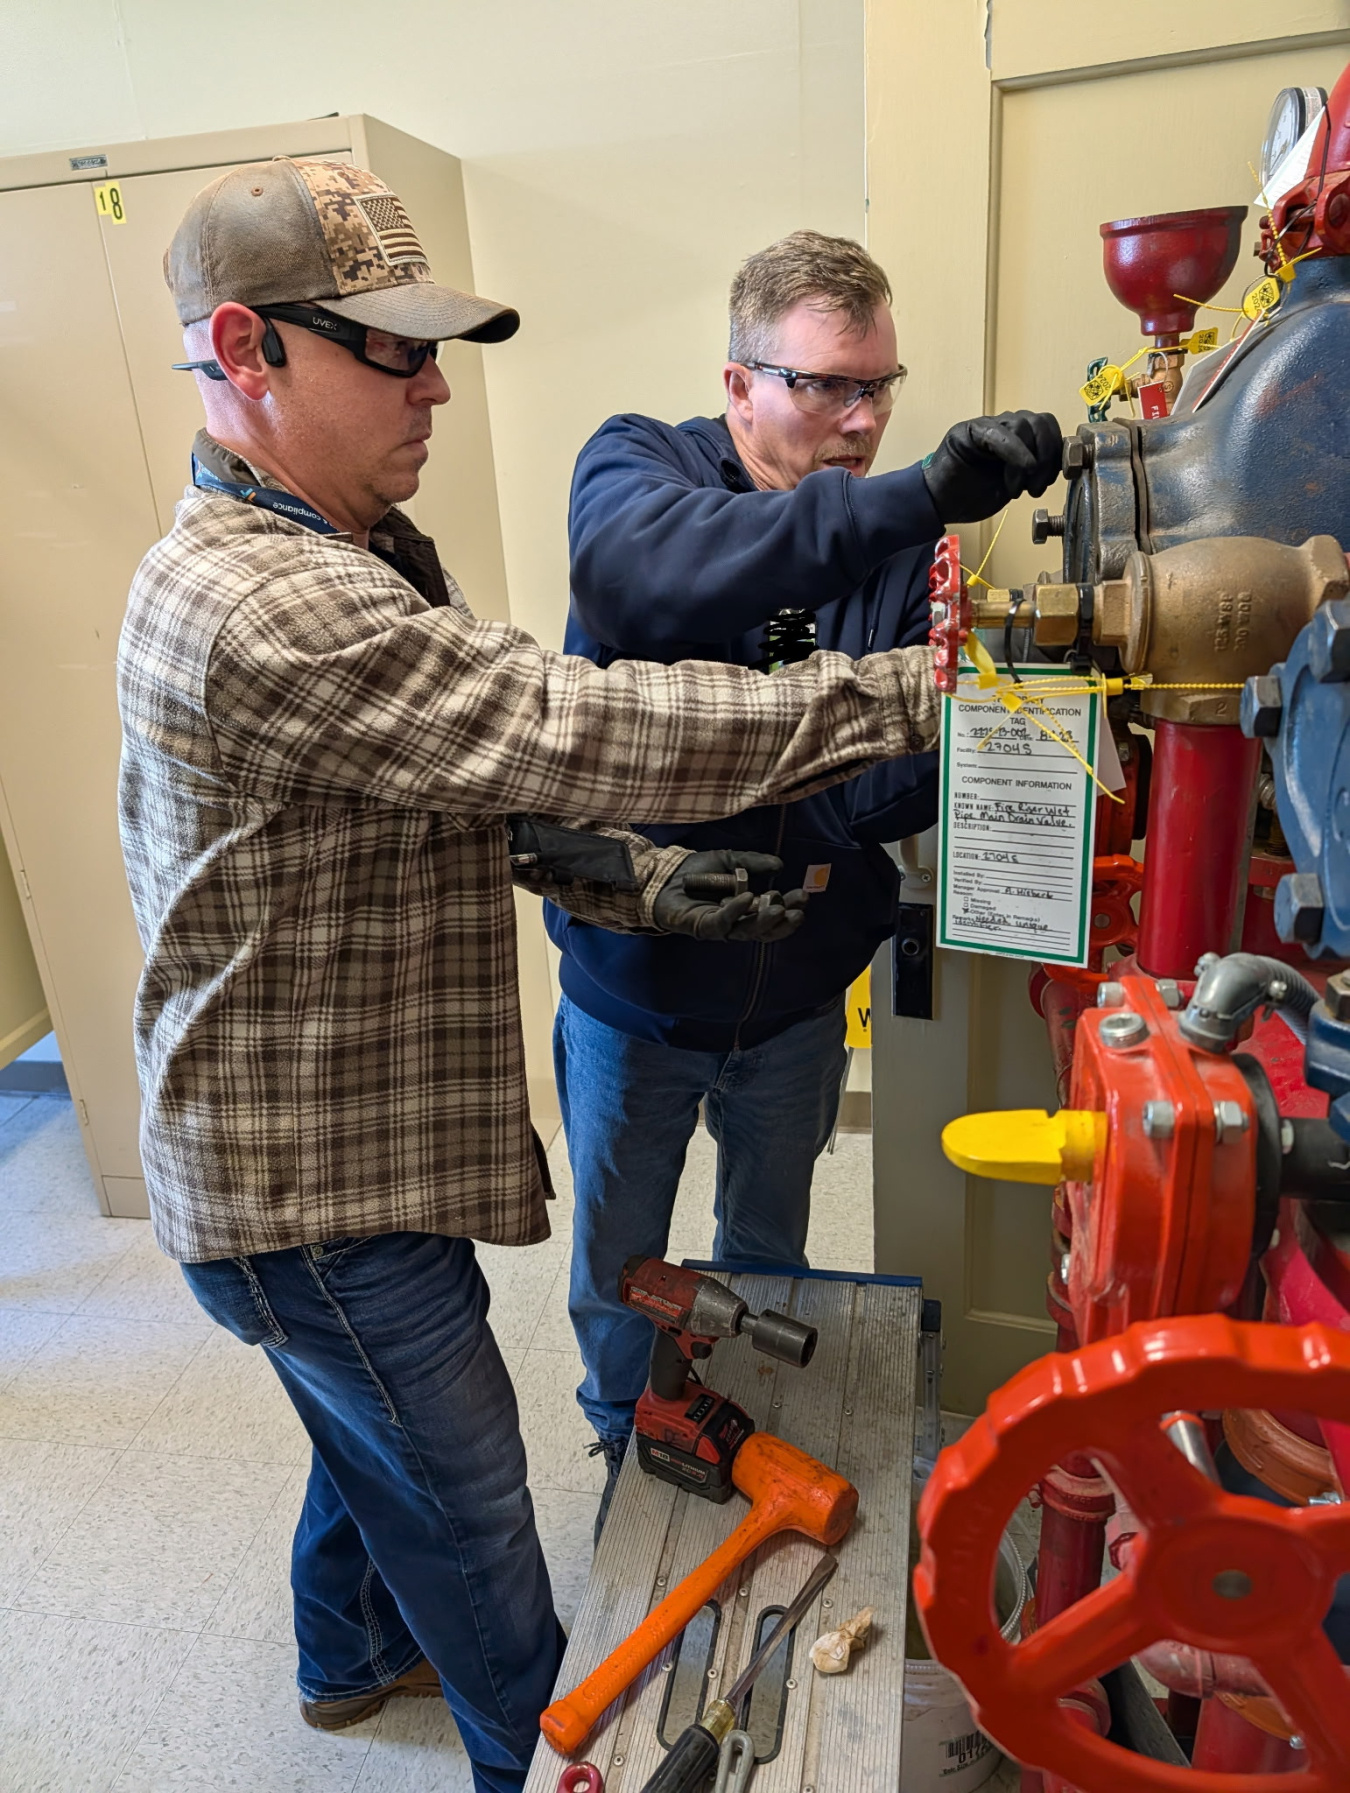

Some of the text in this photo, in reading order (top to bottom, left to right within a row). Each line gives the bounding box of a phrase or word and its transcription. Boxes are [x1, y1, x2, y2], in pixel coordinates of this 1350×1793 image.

[99, 187, 123, 220] 18
[312, 316, 338, 331] UVEX
[272, 501, 322, 521] compliance
[1014, 705, 1082, 717] DENTIFCATION
[1216, 702, 1227, 717] 2
[1009, 717, 1026, 726] TAG
[962, 775, 1072, 791] COMPONENT INFORMATION
[954, 791, 980, 800] NUMBER:
[954, 802, 994, 812] KNOWN NAME:
[953, 809, 974, 822] Pipe
[979, 812, 1005, 823] Main
[1007, 812, 1036, 825] Drain
[953, 822, 992, 831] DESCRIPTION:
[953, 851, 981, 860] LOCATION:
[970, 897, 991, 905] Missing
[970, 903, 997, 911] Damaged
